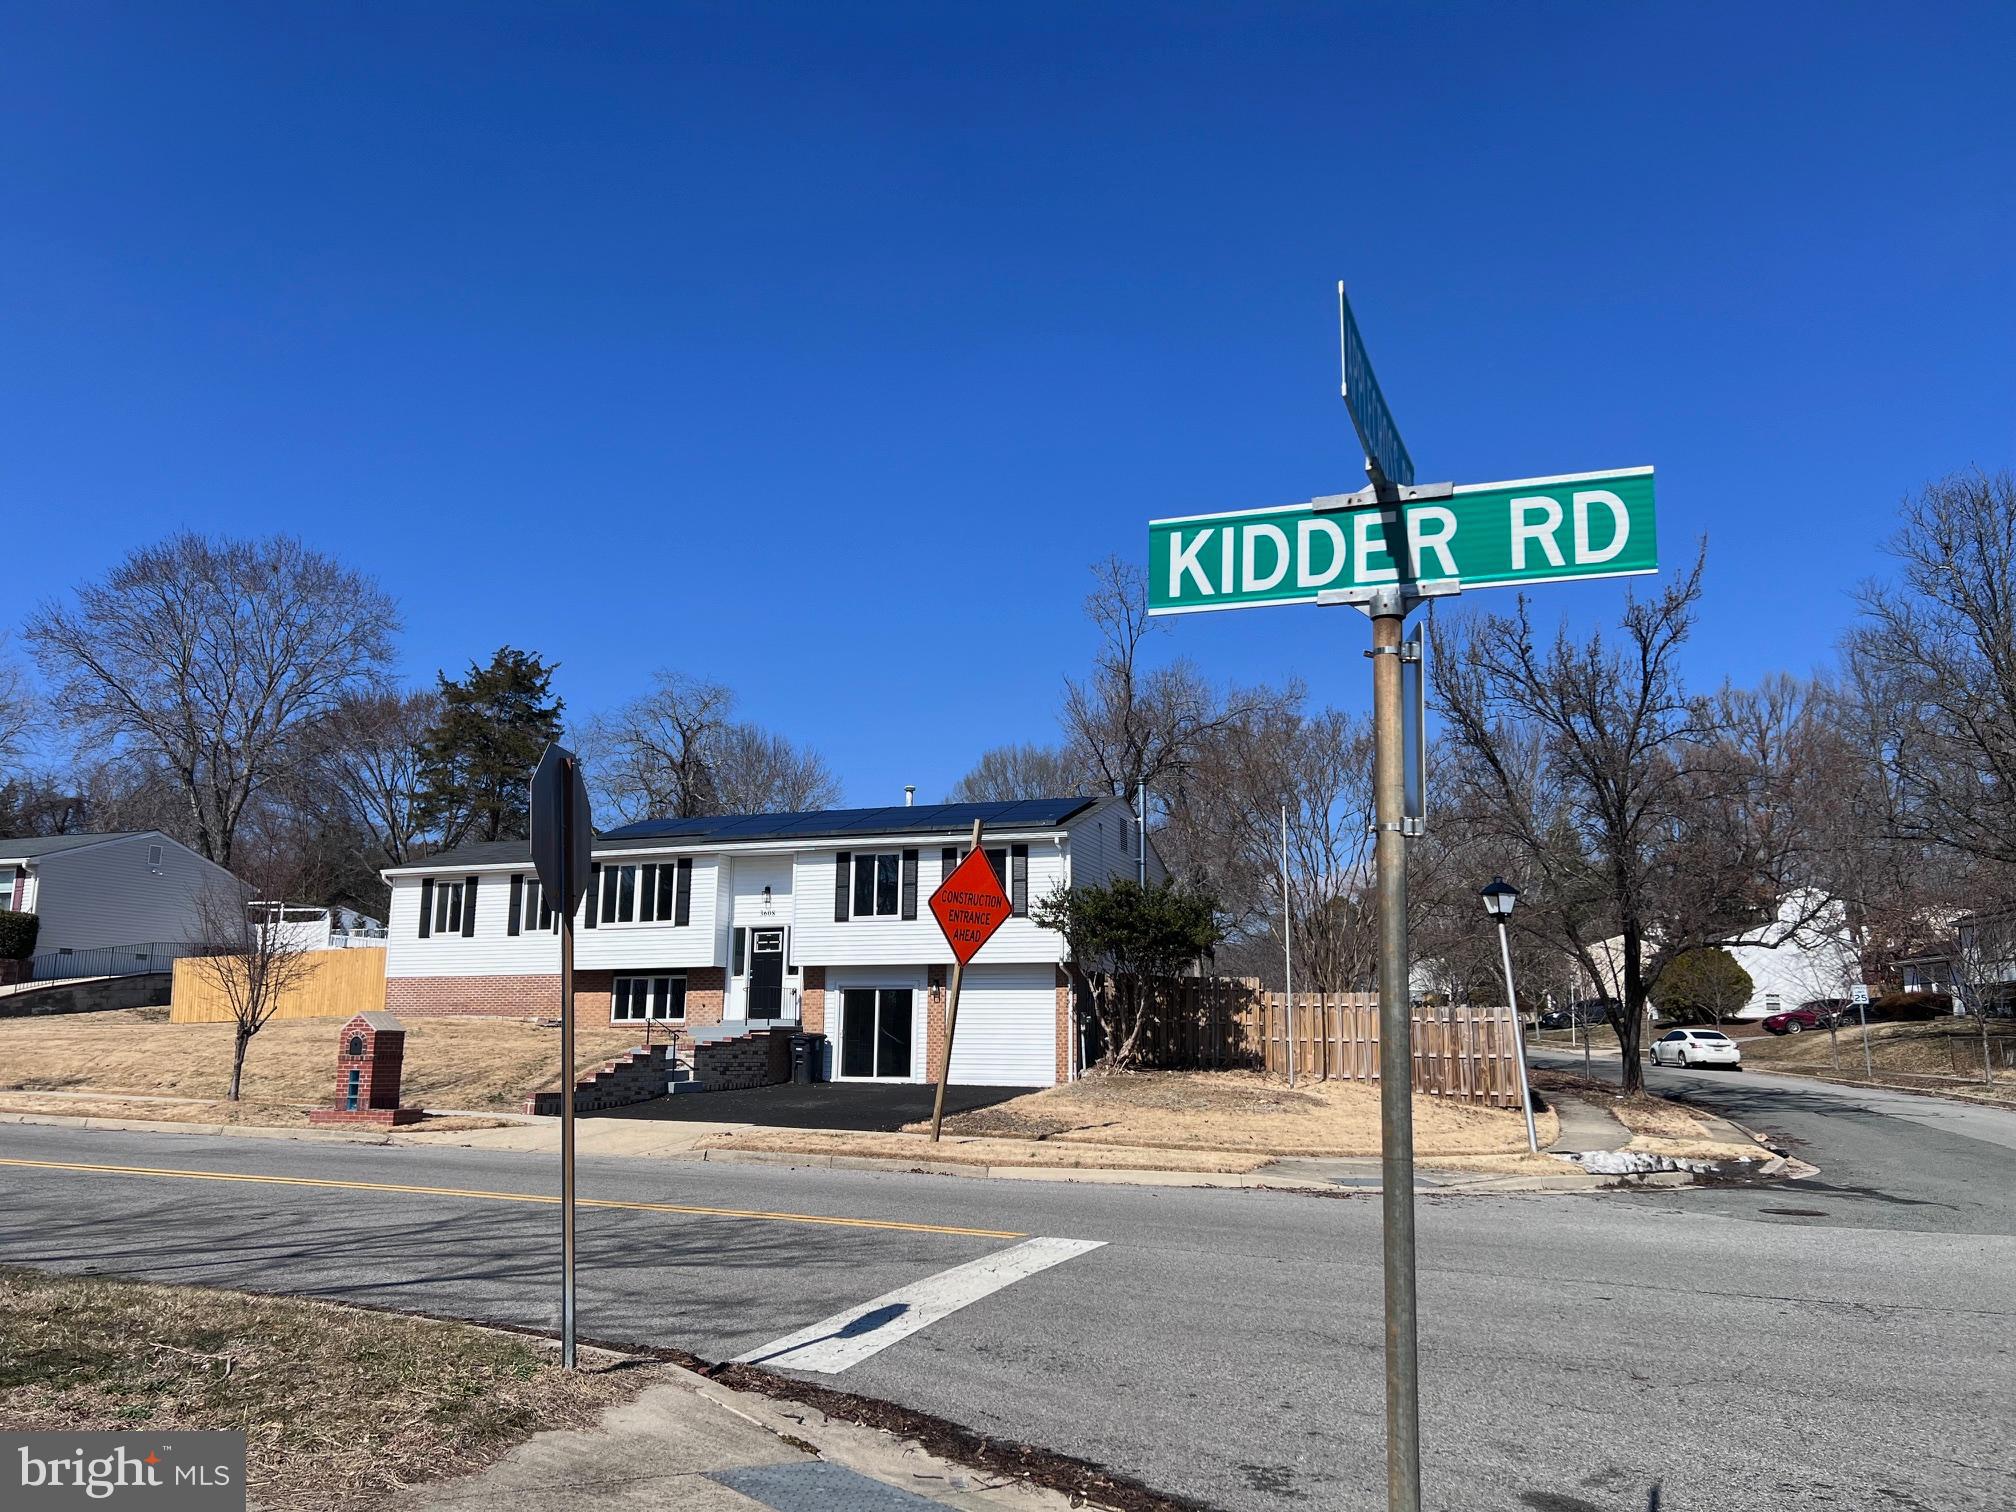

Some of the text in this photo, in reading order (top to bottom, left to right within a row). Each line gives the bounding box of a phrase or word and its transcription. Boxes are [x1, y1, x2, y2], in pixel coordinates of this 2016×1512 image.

[1168, 489, 1631, 598] KIDDER RD
[941, 890, 1003, 908] CONSTRUCTION
[948, 909, 991, 925] ENTRANCE
[953, 928, 981, 942] AHEAD
